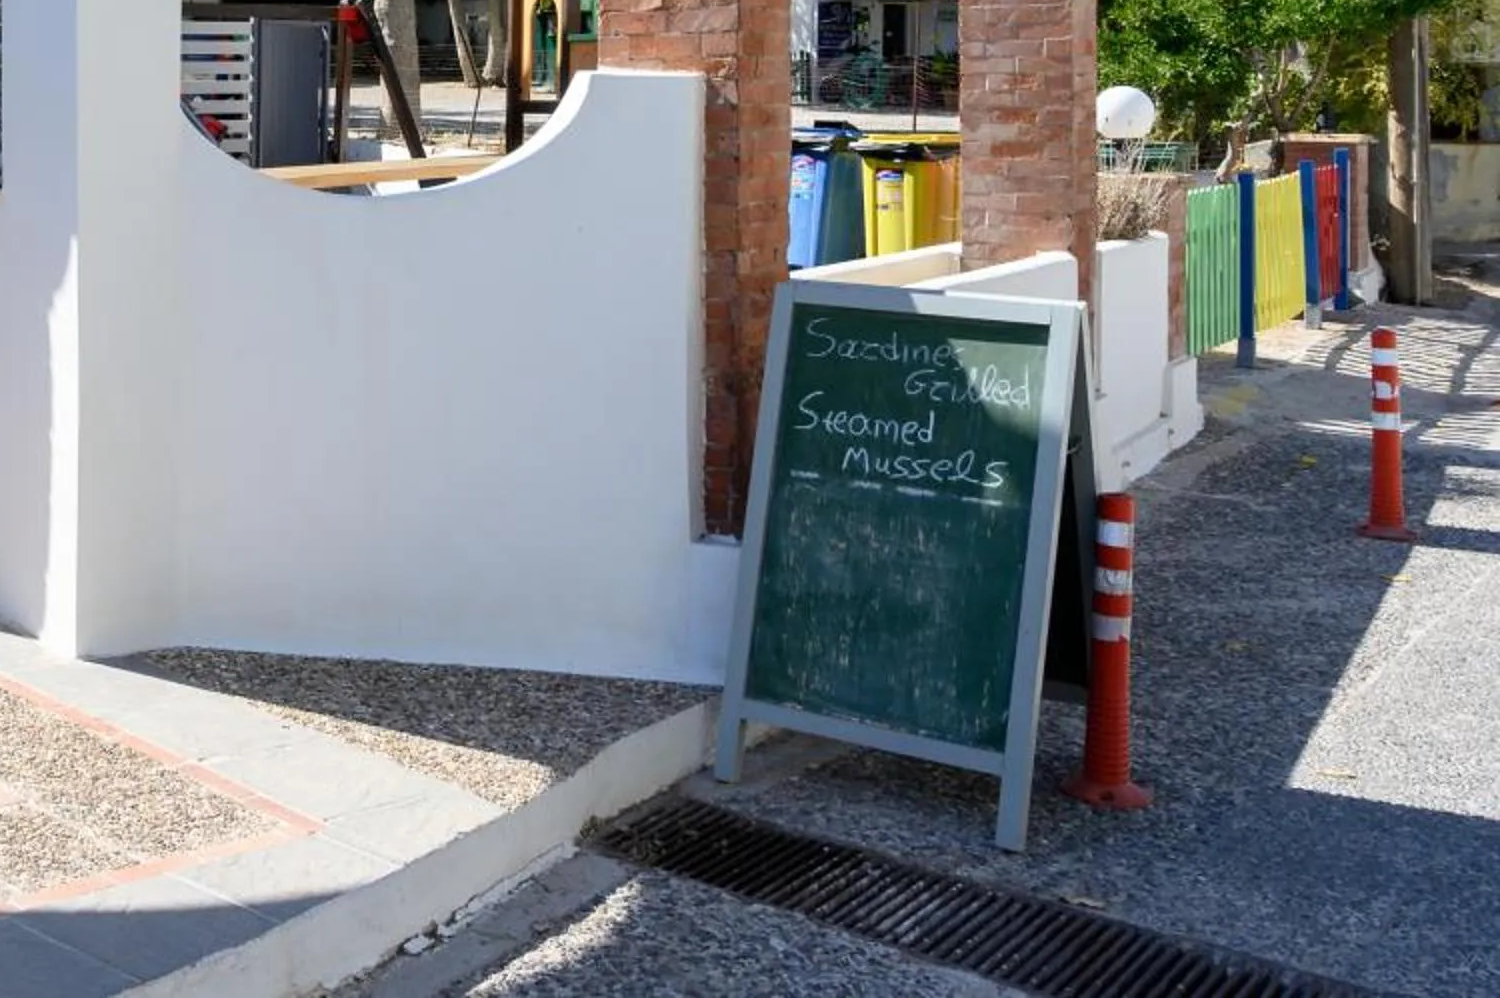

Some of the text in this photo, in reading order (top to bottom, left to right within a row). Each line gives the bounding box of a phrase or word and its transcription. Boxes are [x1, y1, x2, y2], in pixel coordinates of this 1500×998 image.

[903, 363, 1031, 411] Grilled
[793, 390, 936, 446] Steamed
[841, 446, 1009, 488] Mussels
